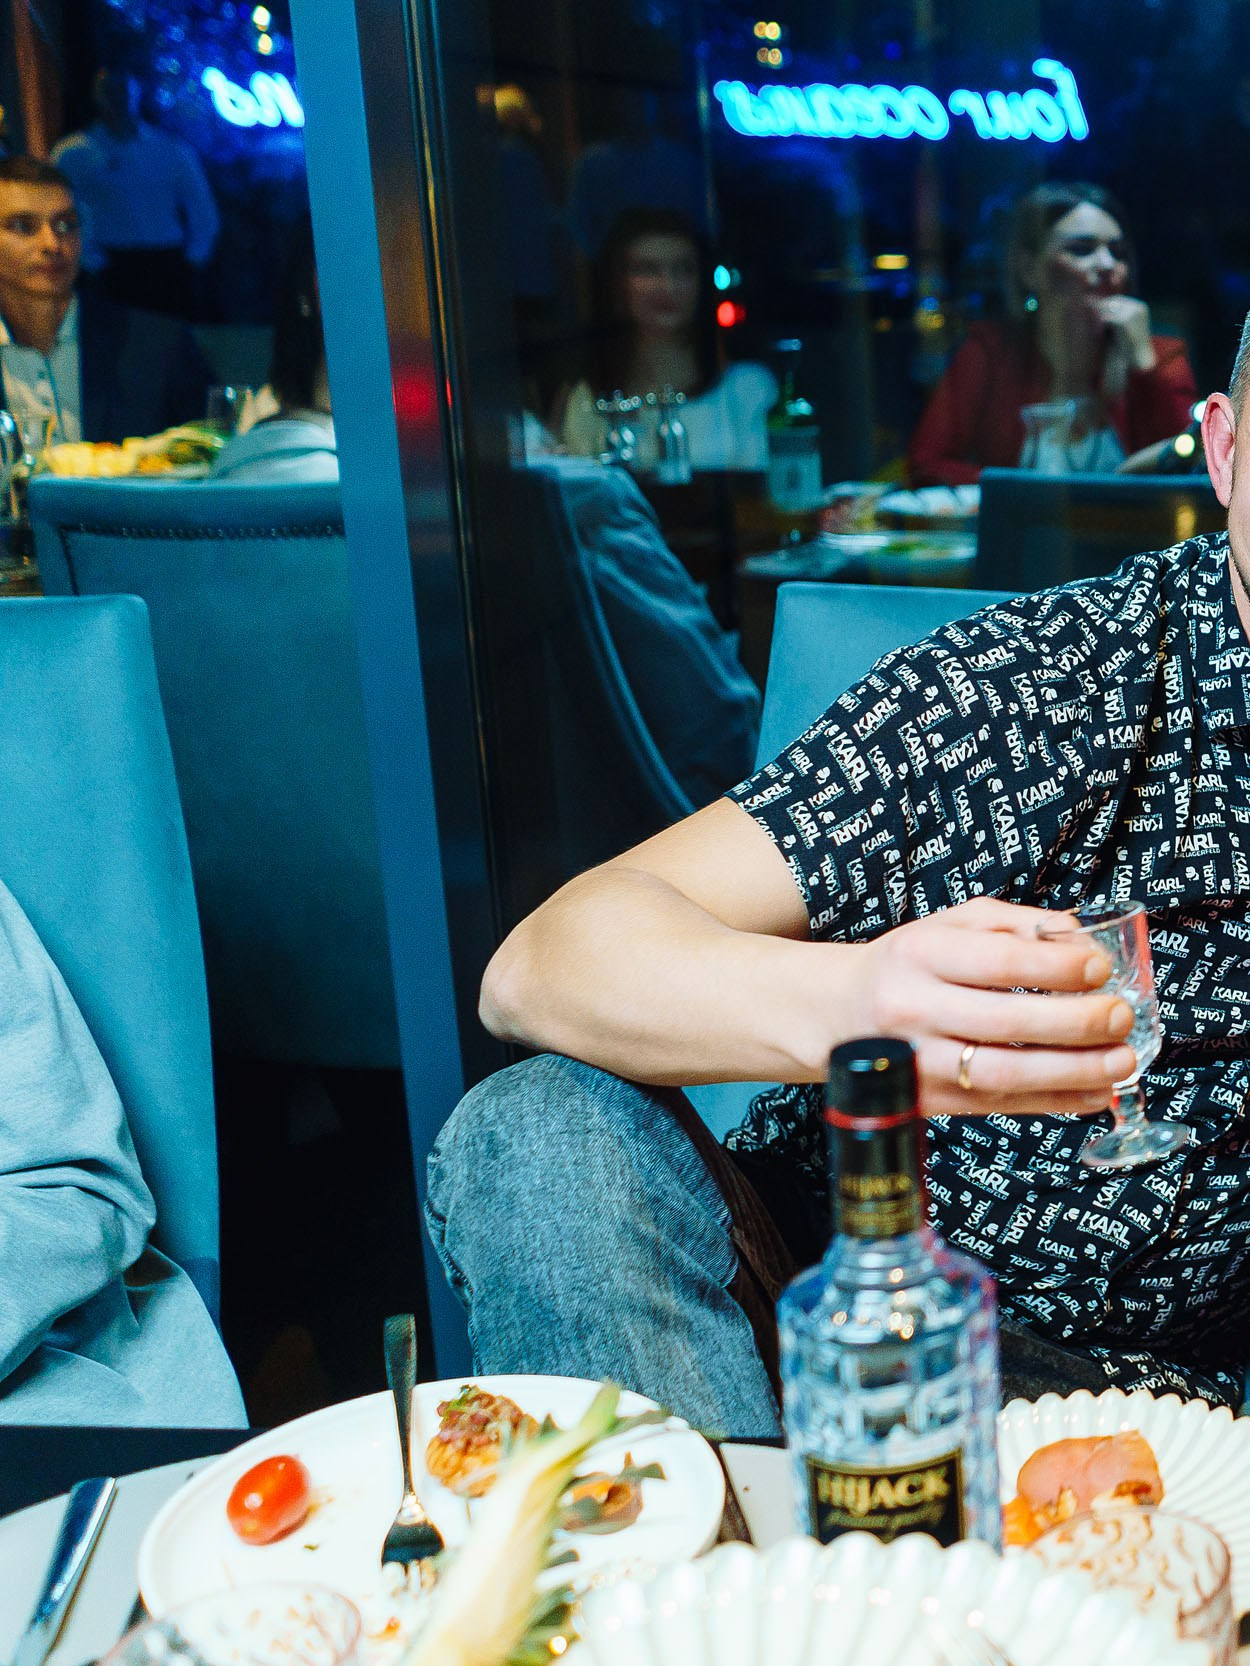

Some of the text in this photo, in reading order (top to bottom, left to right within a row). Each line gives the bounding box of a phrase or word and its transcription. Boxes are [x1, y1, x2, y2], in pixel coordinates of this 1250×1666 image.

[1134, 556, 1158, 569] KARL
[1035, 594, 1058, 619] KARL
[1090, 589, 1114, 610] KARL
[1119, 582, 1153, 620] KARL
[1039, 610, 1073, 637] KARL
[1079, 618, 1098, 650] KARL
[1132, 610, 1156, 637] KARL
[964, 645, 1015, 668] KARL
[1098, 647, 1133, 679] KARL
[895, 664, 921, 691] KARL
[940, 658, 979, 715] KARL
[1033, 668, 1066, 681] KARL
[1163, 656, 1180, 704] KARL
[1199, 677, 1231, 692] KARL
[980, 680, 1004, 718] KARL
[1014, 672, 1039, 720] KARL
[1105, 688, 1122, 722] KAR
[853, 698, 899, 737] KARL
[917, 703, 951, 729] KARL
[790, 746, 814, 775] KARL
[900, 721, 930, 776] KARL
[935, 736, 978, 772] KARL
[1005, 722, 1026, 772] KARL
[1059, 741, 1085, 778] KARL
[1146, 751, 1182, 768] KARL
[831, 732, 871, 792] KARL
[869, 745, 894, 788] KARL
[966, 757, 997, 781] KARL
[738, 783, 790, 811] KARL
[809, 782, 844, 808] KARL
[1016, 777, 1063, 809] KARL
[1134, 783, 1165, 797] KARL
[1175, 779, 1190, 828] KARL
[789, 801, 821, 847] KARL
[954, 785, 974, 835] KARL
[1084, 800, 1113, 848] KARL
[1124, 817, 1163, 832] KARL
[1193, 813, 1226, 826] KARL
[826, 812, 873, 846] KARL
[861, 830, 894, 854] KARL
[993, 795, 1022, 864] KARL
[1175, 832, 1219, 853] KARL
[908, 835, 950, 871] KARL
[1027, 824, 1043, 867] KARL
[964, 850, 994, 875] KARL
[1140, 847, 1153, 880] KARL
[1235, 851, 1250, 894] KARL
[850, 858, 867, 900] KARL
[948, 867, 967, 905] KAR
[1147, 877, 1184, 892] KARL
[1203, 860, 1214, 895] KARL
[912, 882, 930, 918] KARL
[850, 914, 885, 936] KARL
[1178, 915, 1209, 933] KARL
[1181, 960, 1213, 1000] KARL
[1212, 955, 1237, 981] KARL
[1212, 986, 1250, 1004] KARL
[1191, 1009, 1226, 1022] KARL
[1163, 1085, 1195, 1122] KARL
[962, 1126, 992, 1147] KARL
[987, 1112, 1021, 1136] KARL
[1038, 1127, 1062, 1155] KARL
[923, 1175, 952, 1203] KARL
[960, 1165, 1010, 1197] KARL
[1207, 1175, 1239, 1185] KARL
[964, 1200, 991, 1229] KARL
[1003, 1204, 1036, 1244] KARL
[1037, 1202, 1062, 1232] KARL
[1080, 1211, 1130, 1245] KARL
[1121, 1204, 1151, 1231] KARL
[950, 1229, 995, 1257] KARL
[1038, 1237, 1078, 1259] KARL
[1181, 1239, 1230, 1258] KARL
[817, 1465, 949, 1518] HIJACK
